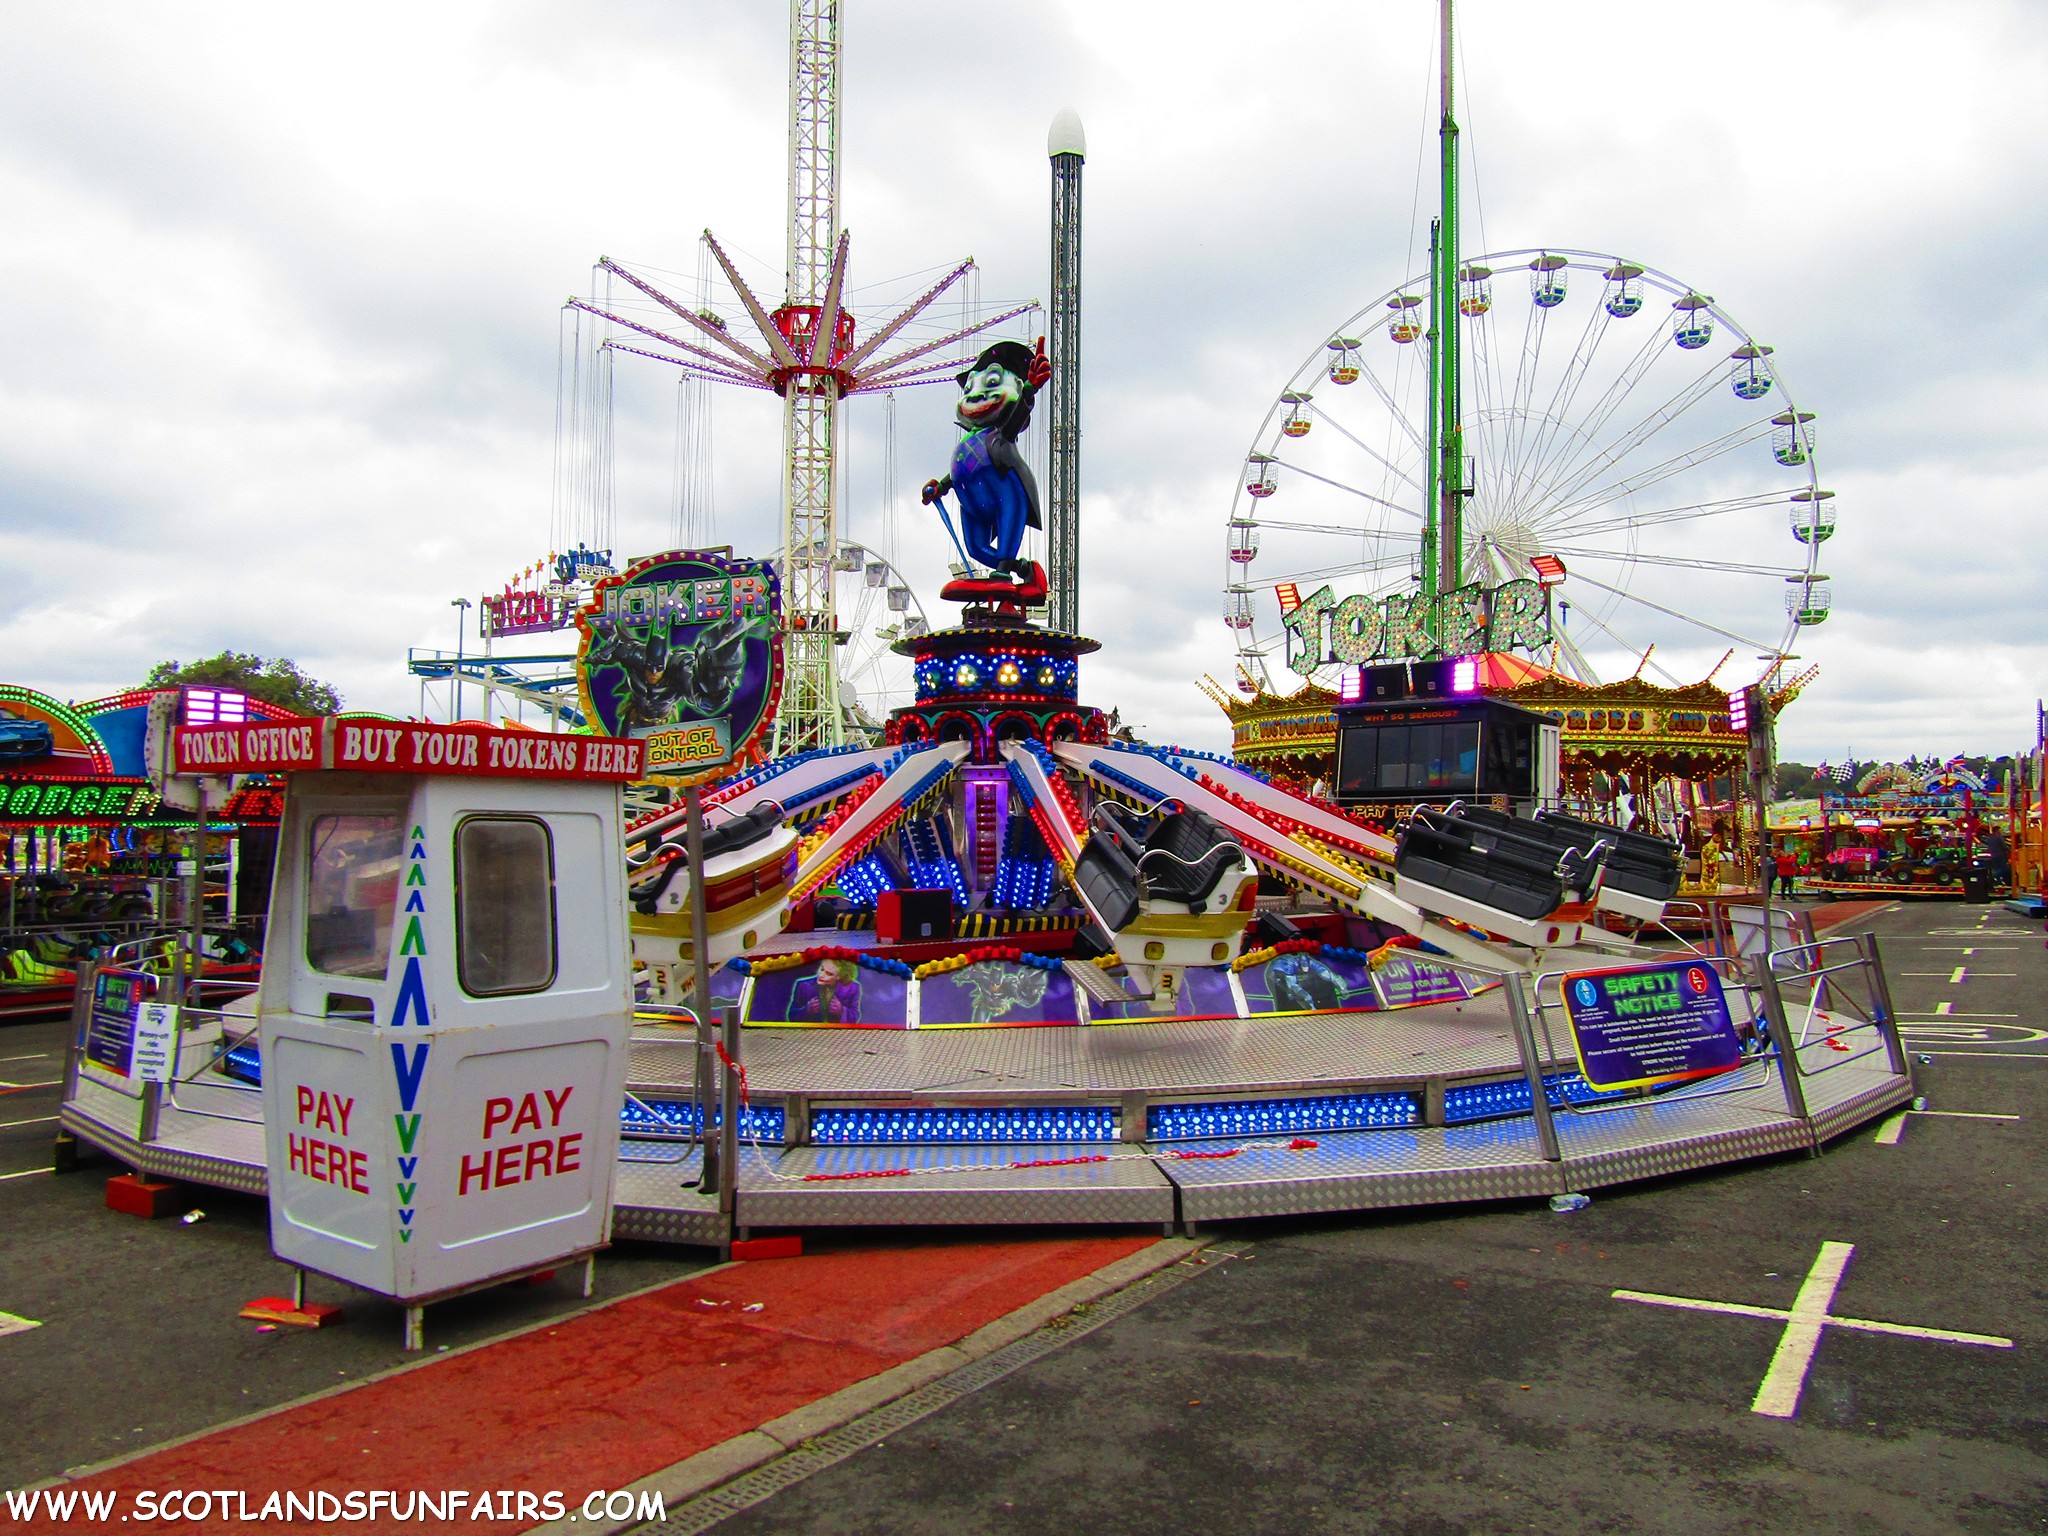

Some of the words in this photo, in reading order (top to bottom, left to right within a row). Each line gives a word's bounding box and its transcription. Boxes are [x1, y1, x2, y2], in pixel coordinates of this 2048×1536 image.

[586, 575, 769, 631] JOKER
[1282, 579, 1554, 675] JOKER
[182, 731, 239, 763] TOKEN
[246, 725, 313, 762] OFFICE
[343, 726, 402, 763] BUY
[411, 730, 479, 766] YOUR
[489, 736, 577, 772] TOKENS
[585, 741, 640, 775] HERE
[648, 743, 722, 762] ONTROL
[689, 730, 713, 743] OF
[670, 892, 679, 905] 2
[1219, 893, 1228, 905] 3
[1604, 972, 1679, 996] SAFETY
[1614, 992, 1681, 1017] NOTICE
[297, 1085, 354, 1137] PAY
[483, 1086, 575, 1139] PAY
[289, 1132, 370, 1195] HERE
[458, 1132, 583, 1196] HERE
